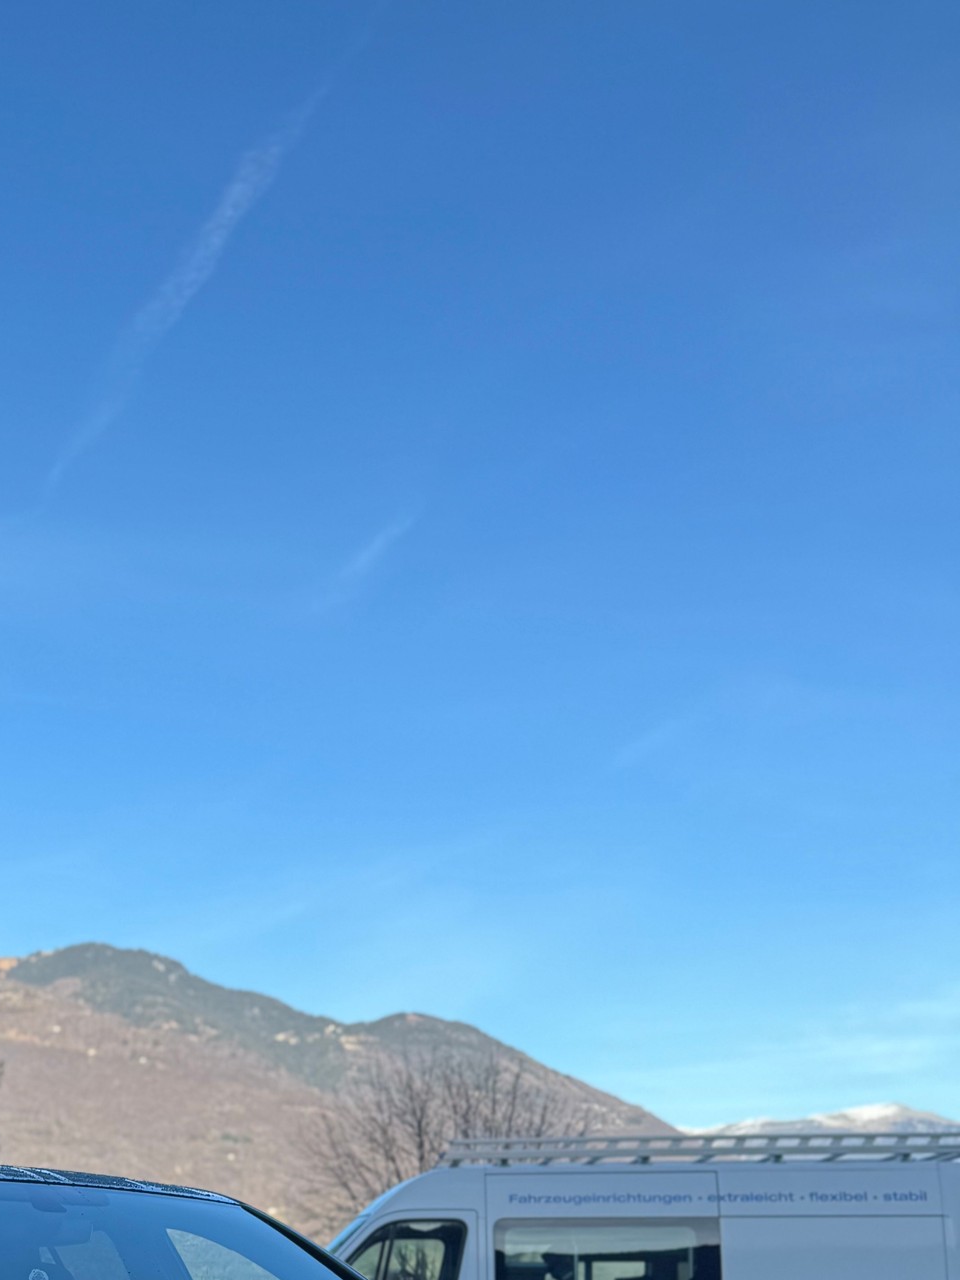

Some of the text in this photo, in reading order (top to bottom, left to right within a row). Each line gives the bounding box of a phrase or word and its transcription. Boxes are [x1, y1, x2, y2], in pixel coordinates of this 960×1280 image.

[508, 1190, 928, 1206] Fahrzeugeinrichtungen extraleicht flexibel stabil
